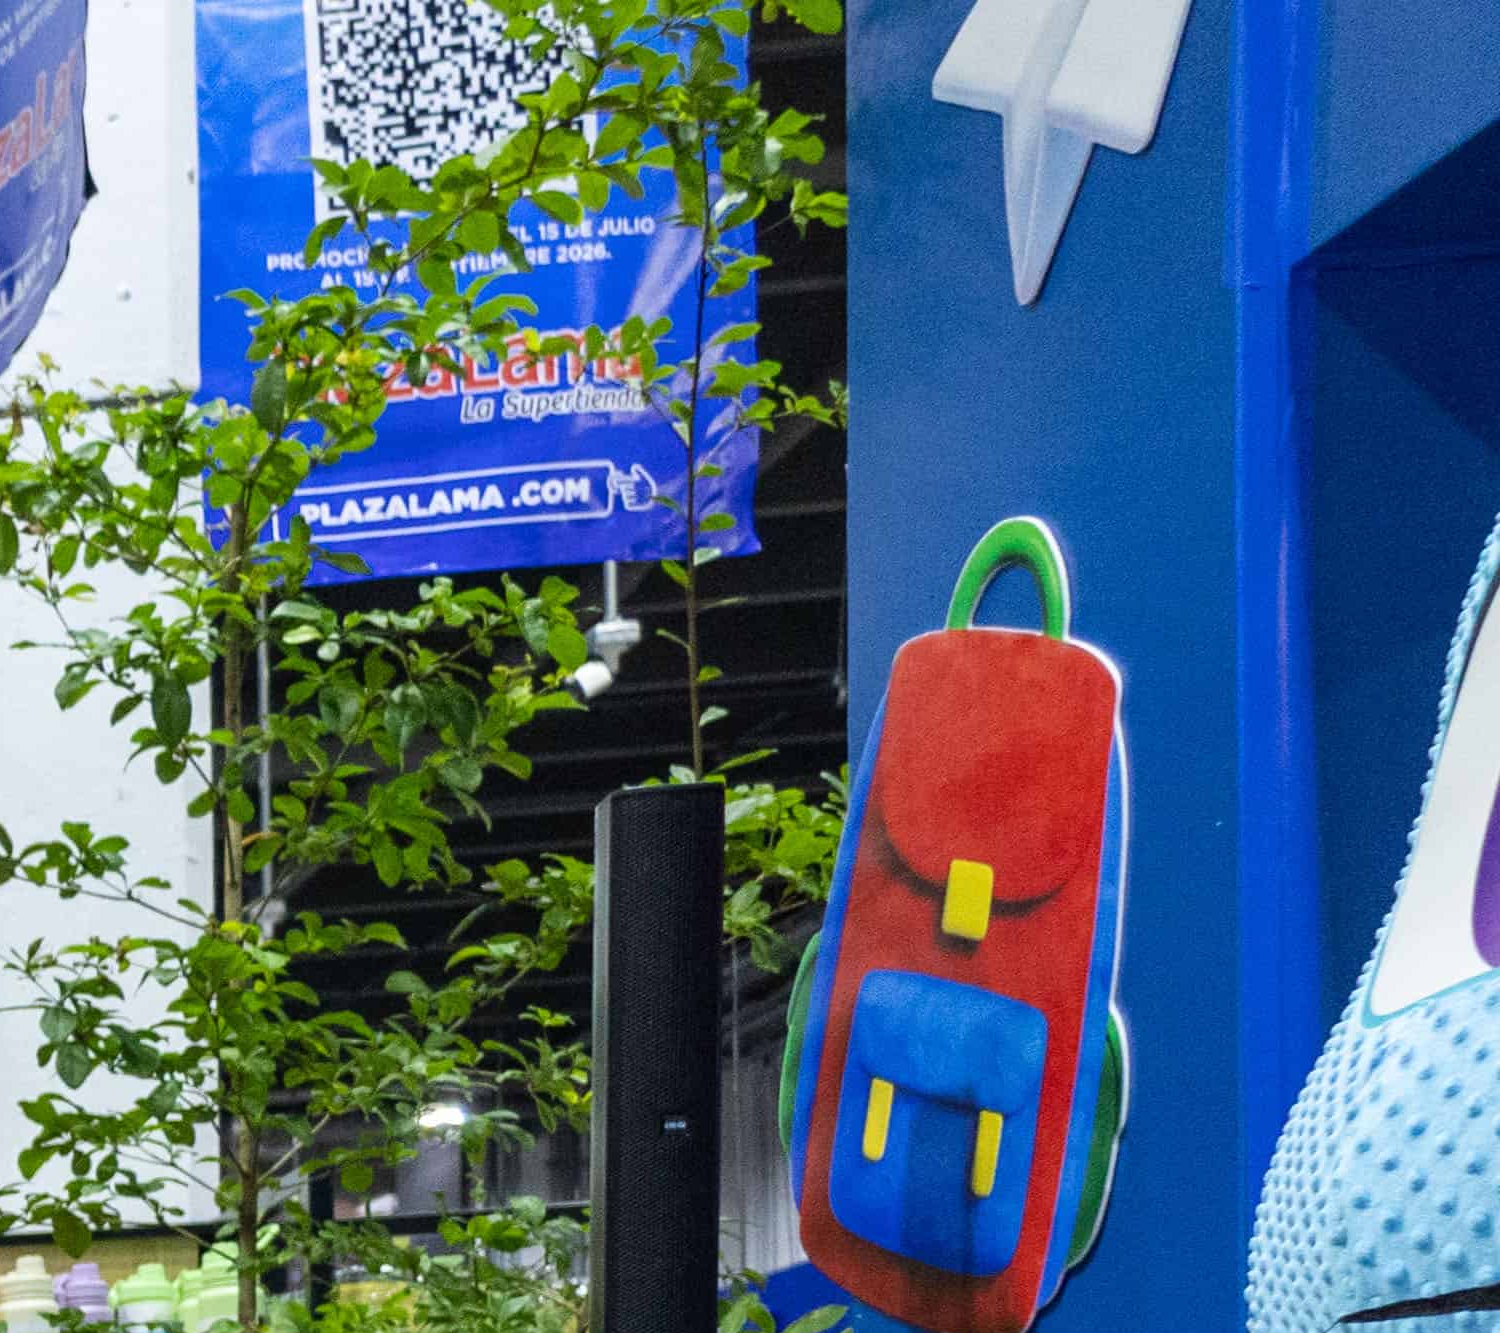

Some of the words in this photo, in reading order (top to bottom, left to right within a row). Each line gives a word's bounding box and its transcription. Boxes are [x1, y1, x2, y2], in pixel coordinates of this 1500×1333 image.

[538, 222, 559, 241] 15
[598, 215, 656, 237] JULIO
[460, 395, 493, 424] La
